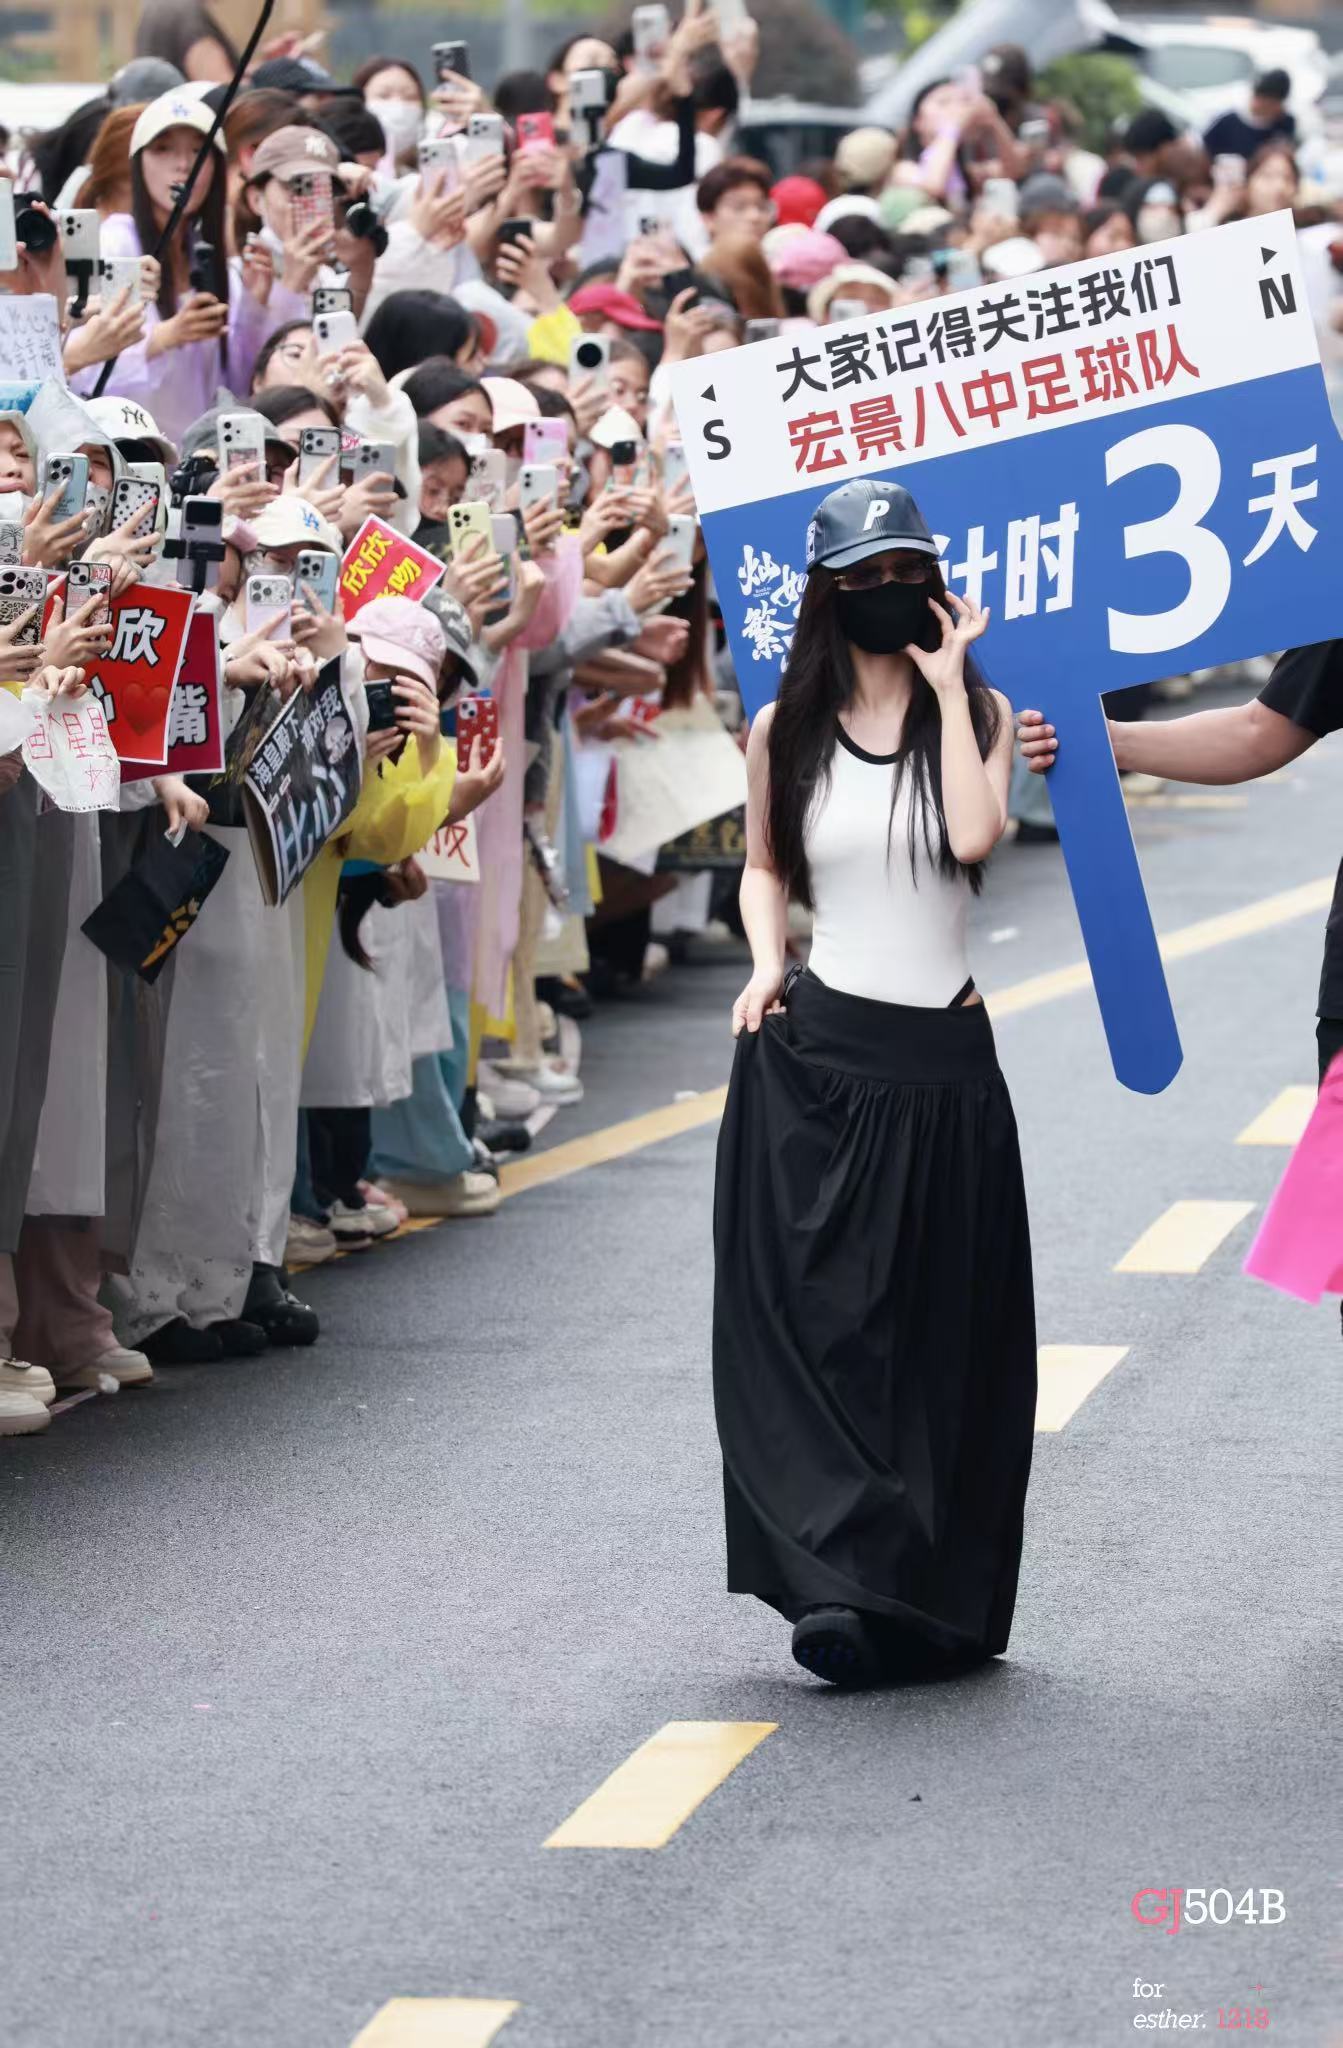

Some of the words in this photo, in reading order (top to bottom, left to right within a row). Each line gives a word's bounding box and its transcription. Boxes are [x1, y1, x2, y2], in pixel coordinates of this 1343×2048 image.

[776, 255, 1181, 401] 大家记得关注我们
[1258, 273, 1297, 320] N
[786, 323, 1200, 474] 宏景八中足球队
[702, 418, 731, 461] S
[863, 499, 890, 531] P
[341, 529, 394, 597] 欣欣
[101, 608, 167, 667] 欣
[253, 707, 300, 792] 海皇殿下
